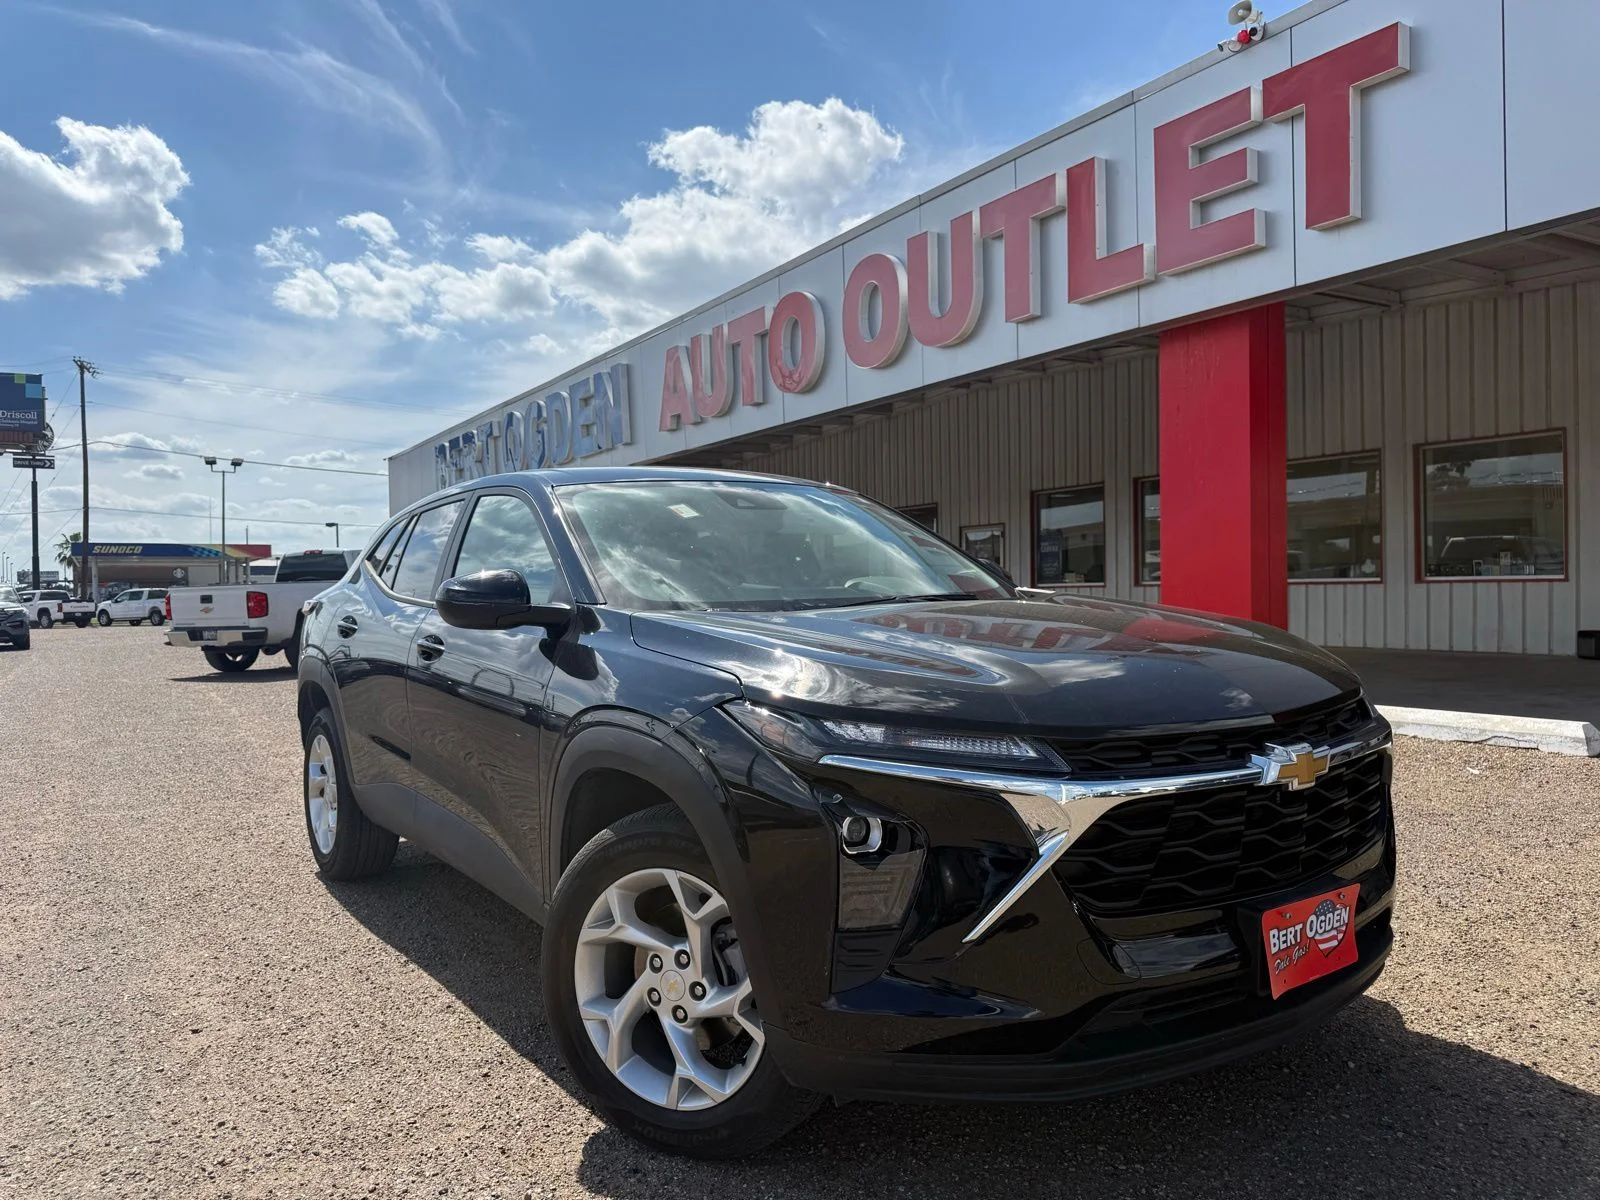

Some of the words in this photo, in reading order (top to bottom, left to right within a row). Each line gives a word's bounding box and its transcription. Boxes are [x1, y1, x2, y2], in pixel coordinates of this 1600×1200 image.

[435, 421, 501, 489] BERT
[503, 362, 633, 473] OGDEN
[659, 291, 826, 432] AUTO
[842, 21, 1410, 370] OUTLET
[0, 410, 37, 419] Driscoll
[92, 545, 143, 554] SUNOCO
[1269, 923, 1304, 955] BERT
[1306, 906, 1350, 938] OGDEN
